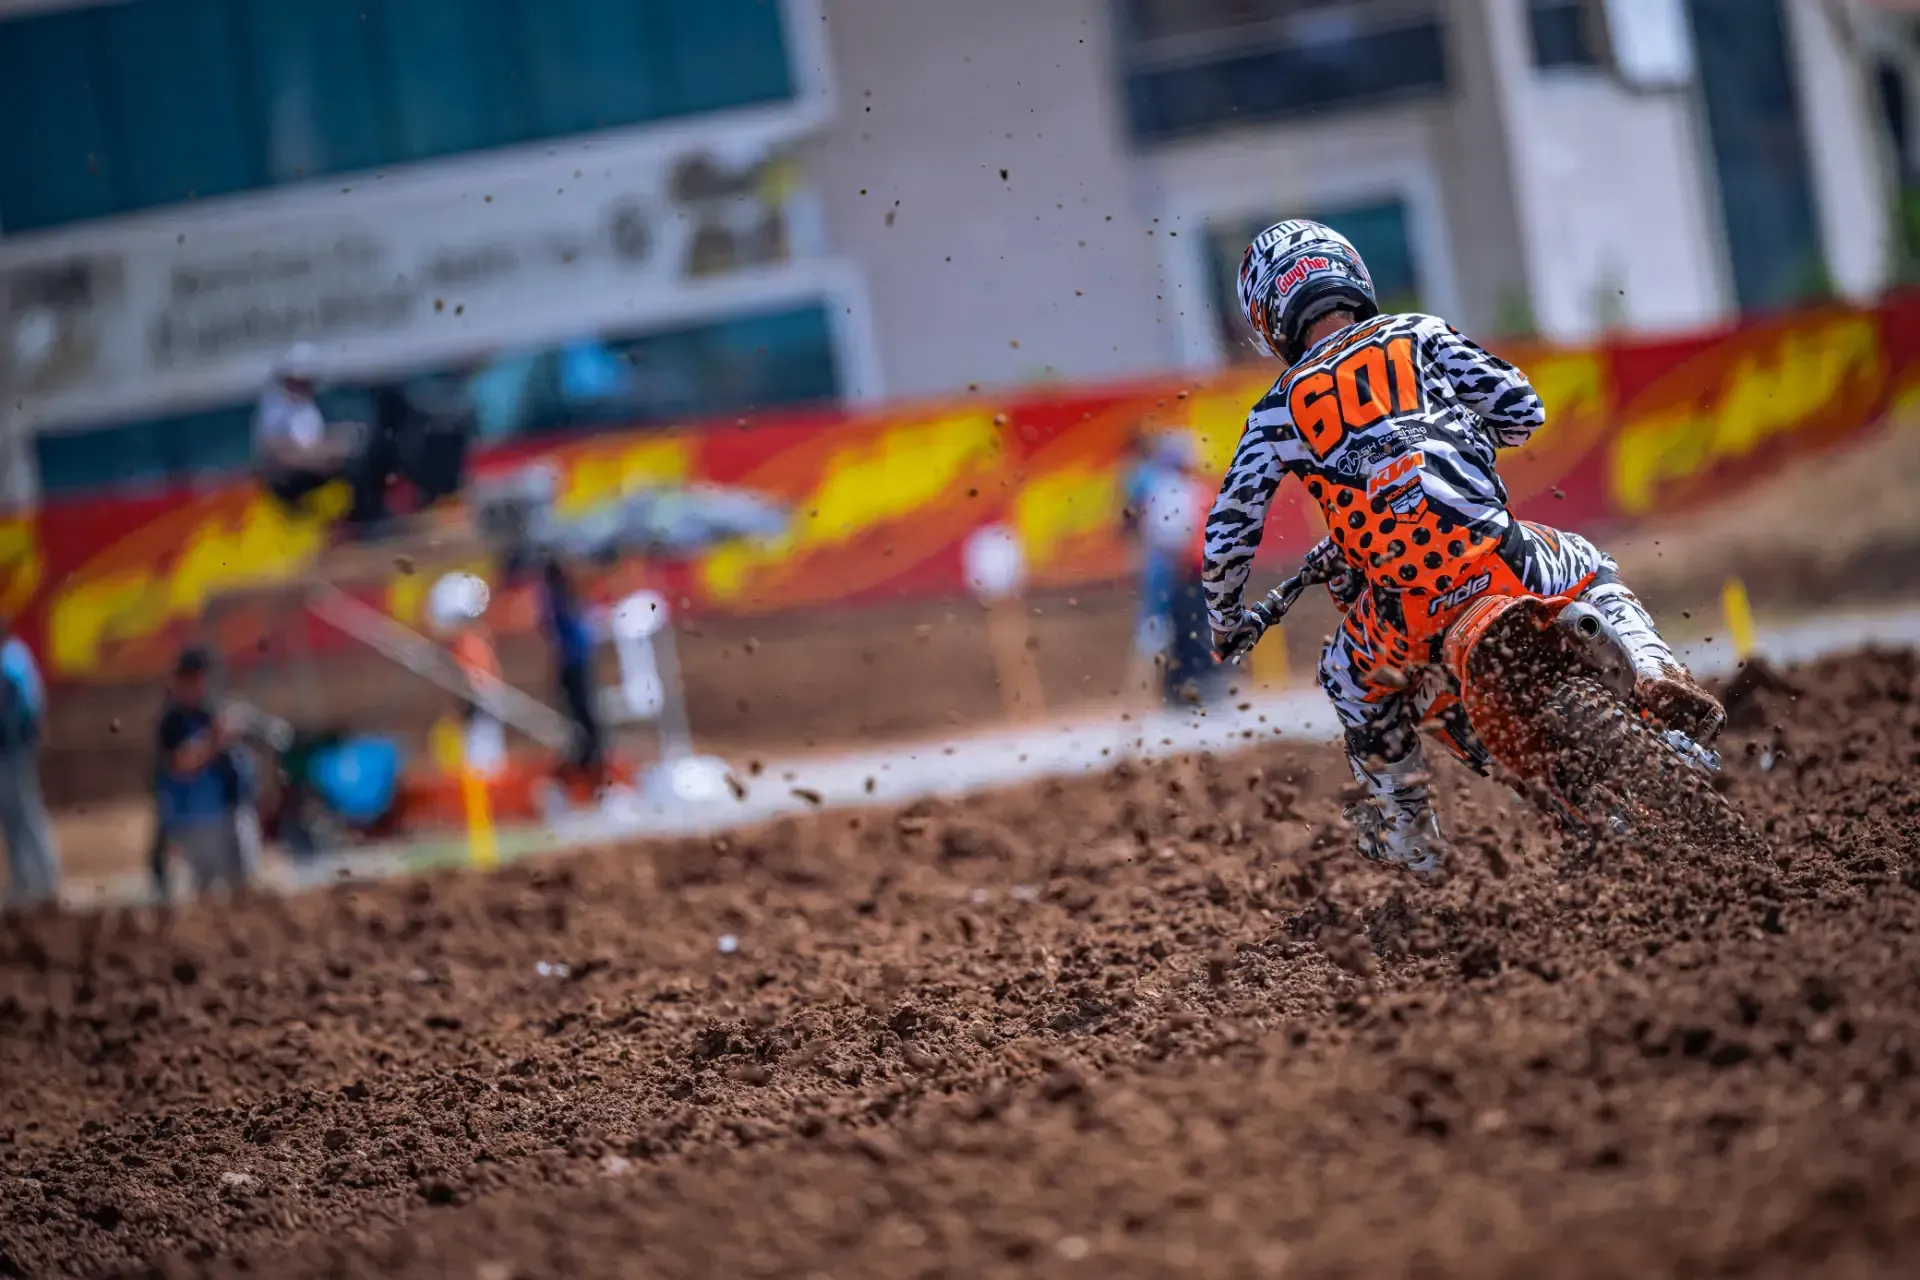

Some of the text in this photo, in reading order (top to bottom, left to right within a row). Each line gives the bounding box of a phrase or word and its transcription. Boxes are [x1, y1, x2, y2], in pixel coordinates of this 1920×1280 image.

[1290, 338, 1419, 459] 601
[1361, 426, 1427, 455] SH Coaching
[1369, 452, 1424, 496] KTM
[1430, 573, 1490, 614] ride
